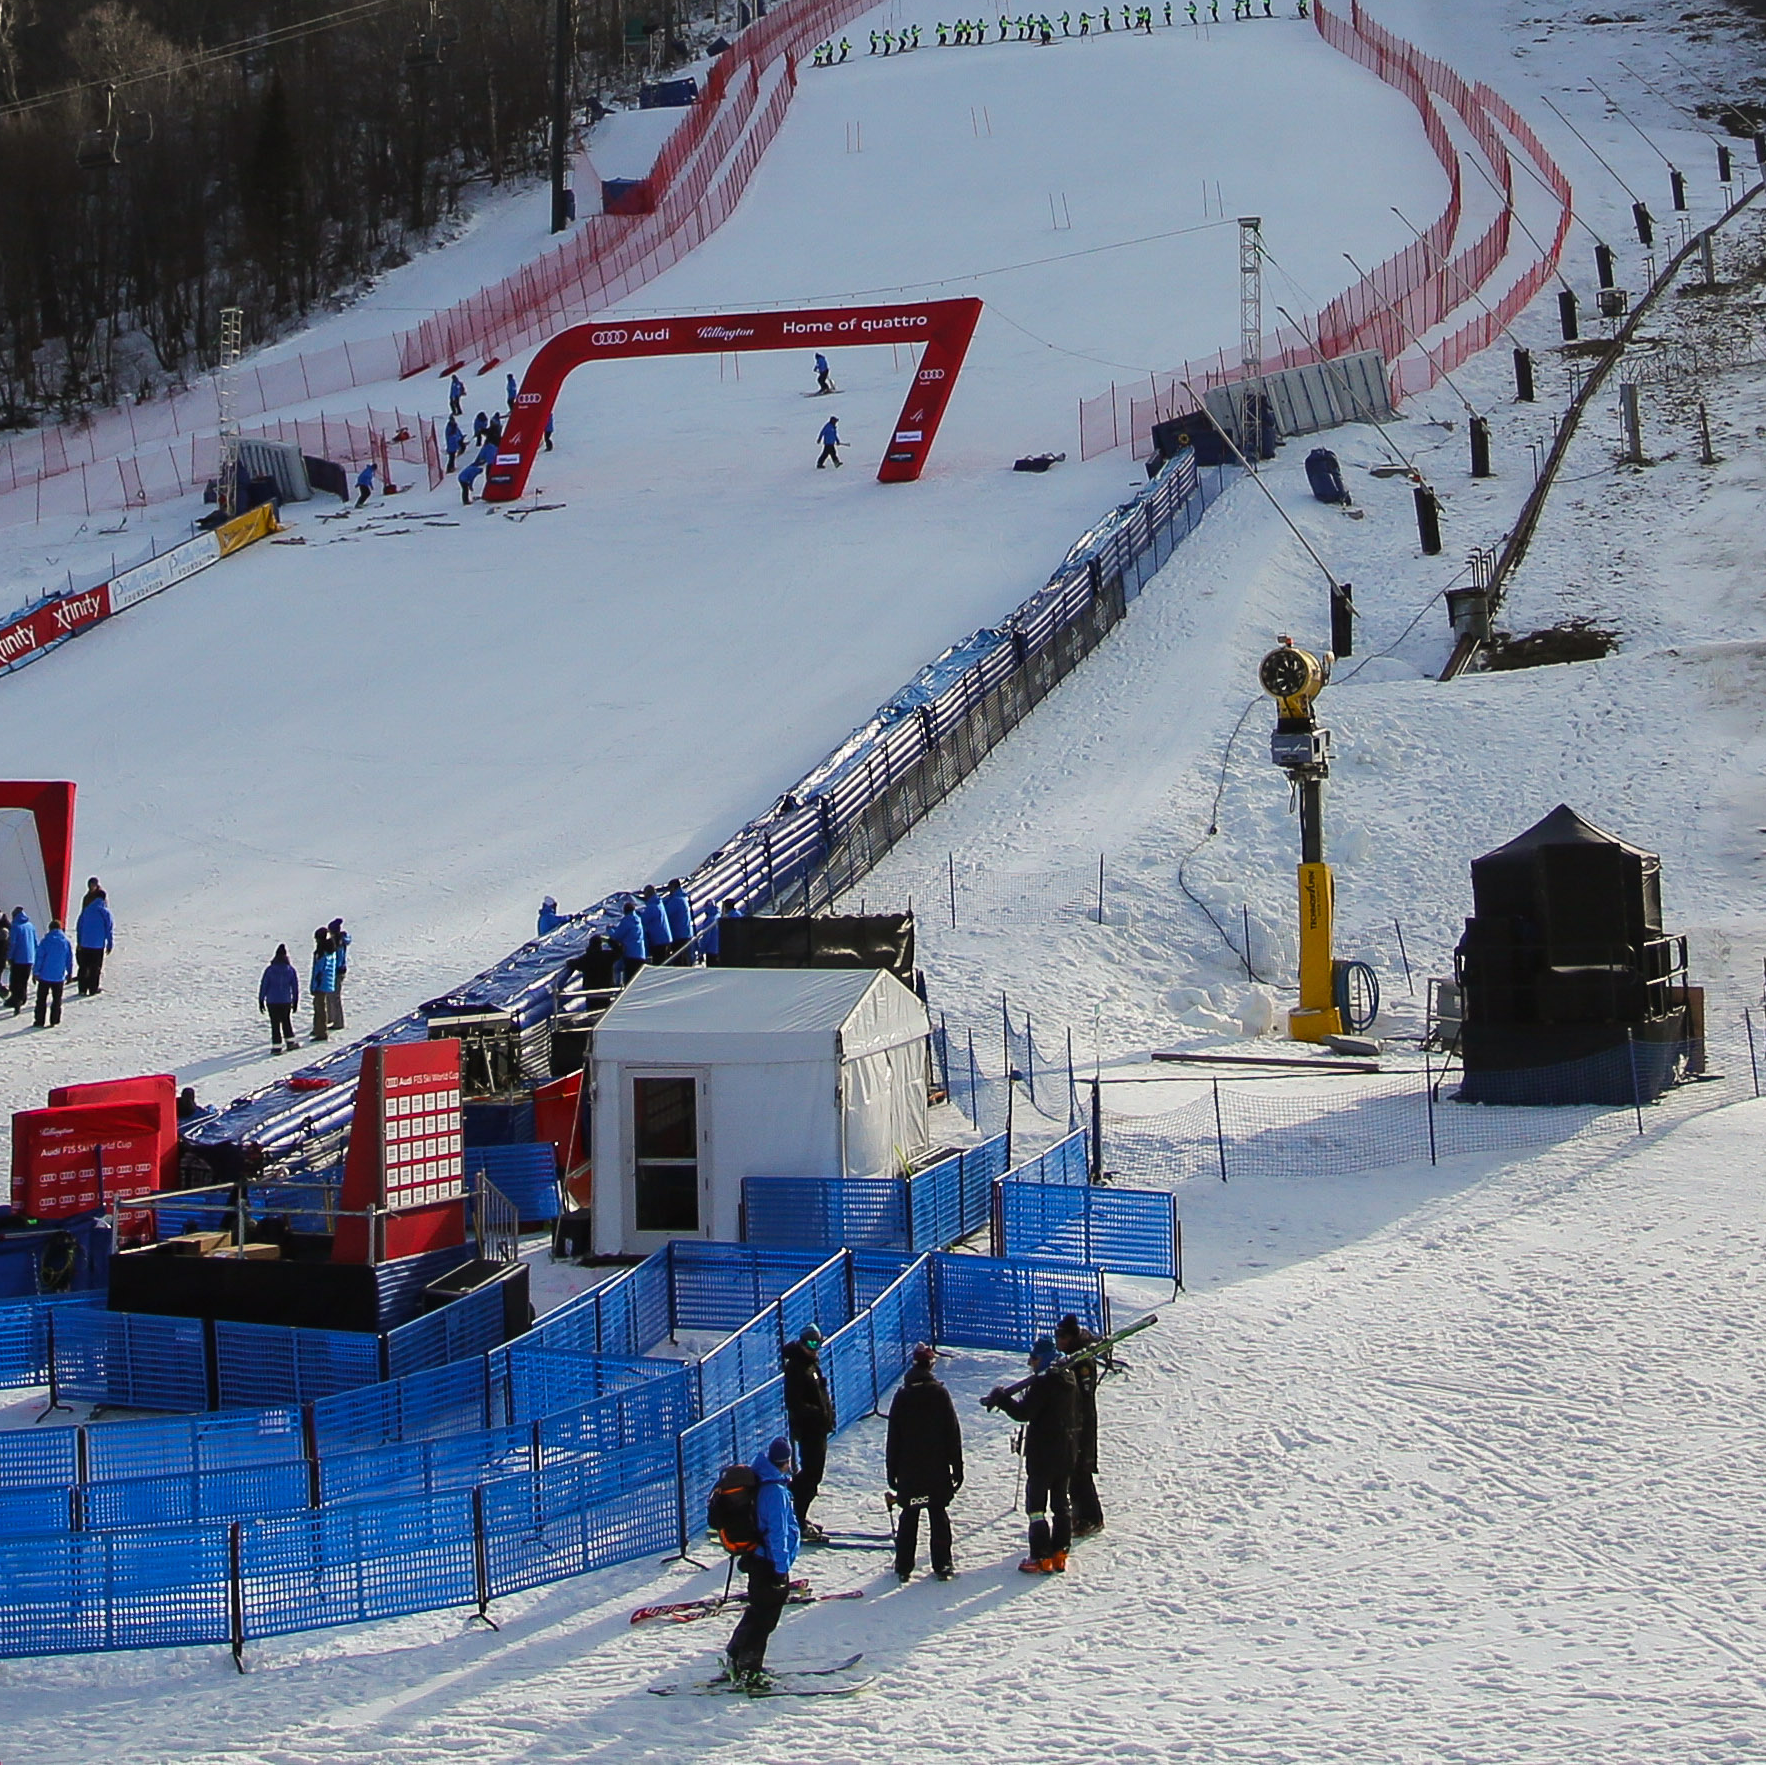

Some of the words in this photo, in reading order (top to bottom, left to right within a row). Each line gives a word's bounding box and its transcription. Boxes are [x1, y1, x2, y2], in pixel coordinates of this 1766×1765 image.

[631, 328, 669, 342] Audi
[697, 325, 754, 342] Killington
[783, 321, 833, 334] Home
[838, 318, 857, 331] of
[861, 315, 928, 332] quattro
[52, 594, 101, 630] xfinity
[399, 1076, 413, 1086] Audi
[413, 1074, 423, 1084] FIS
[423, 1074, 432, 1083] Ski
[432, 1072, 449, 1082] World
[449, 1070, 460, 1081] Cup
[40, 1148, 61, 1157] Audi
[62, 1145, 76, 1154] FIS
[116, 1140, 132, 1149] Cup
